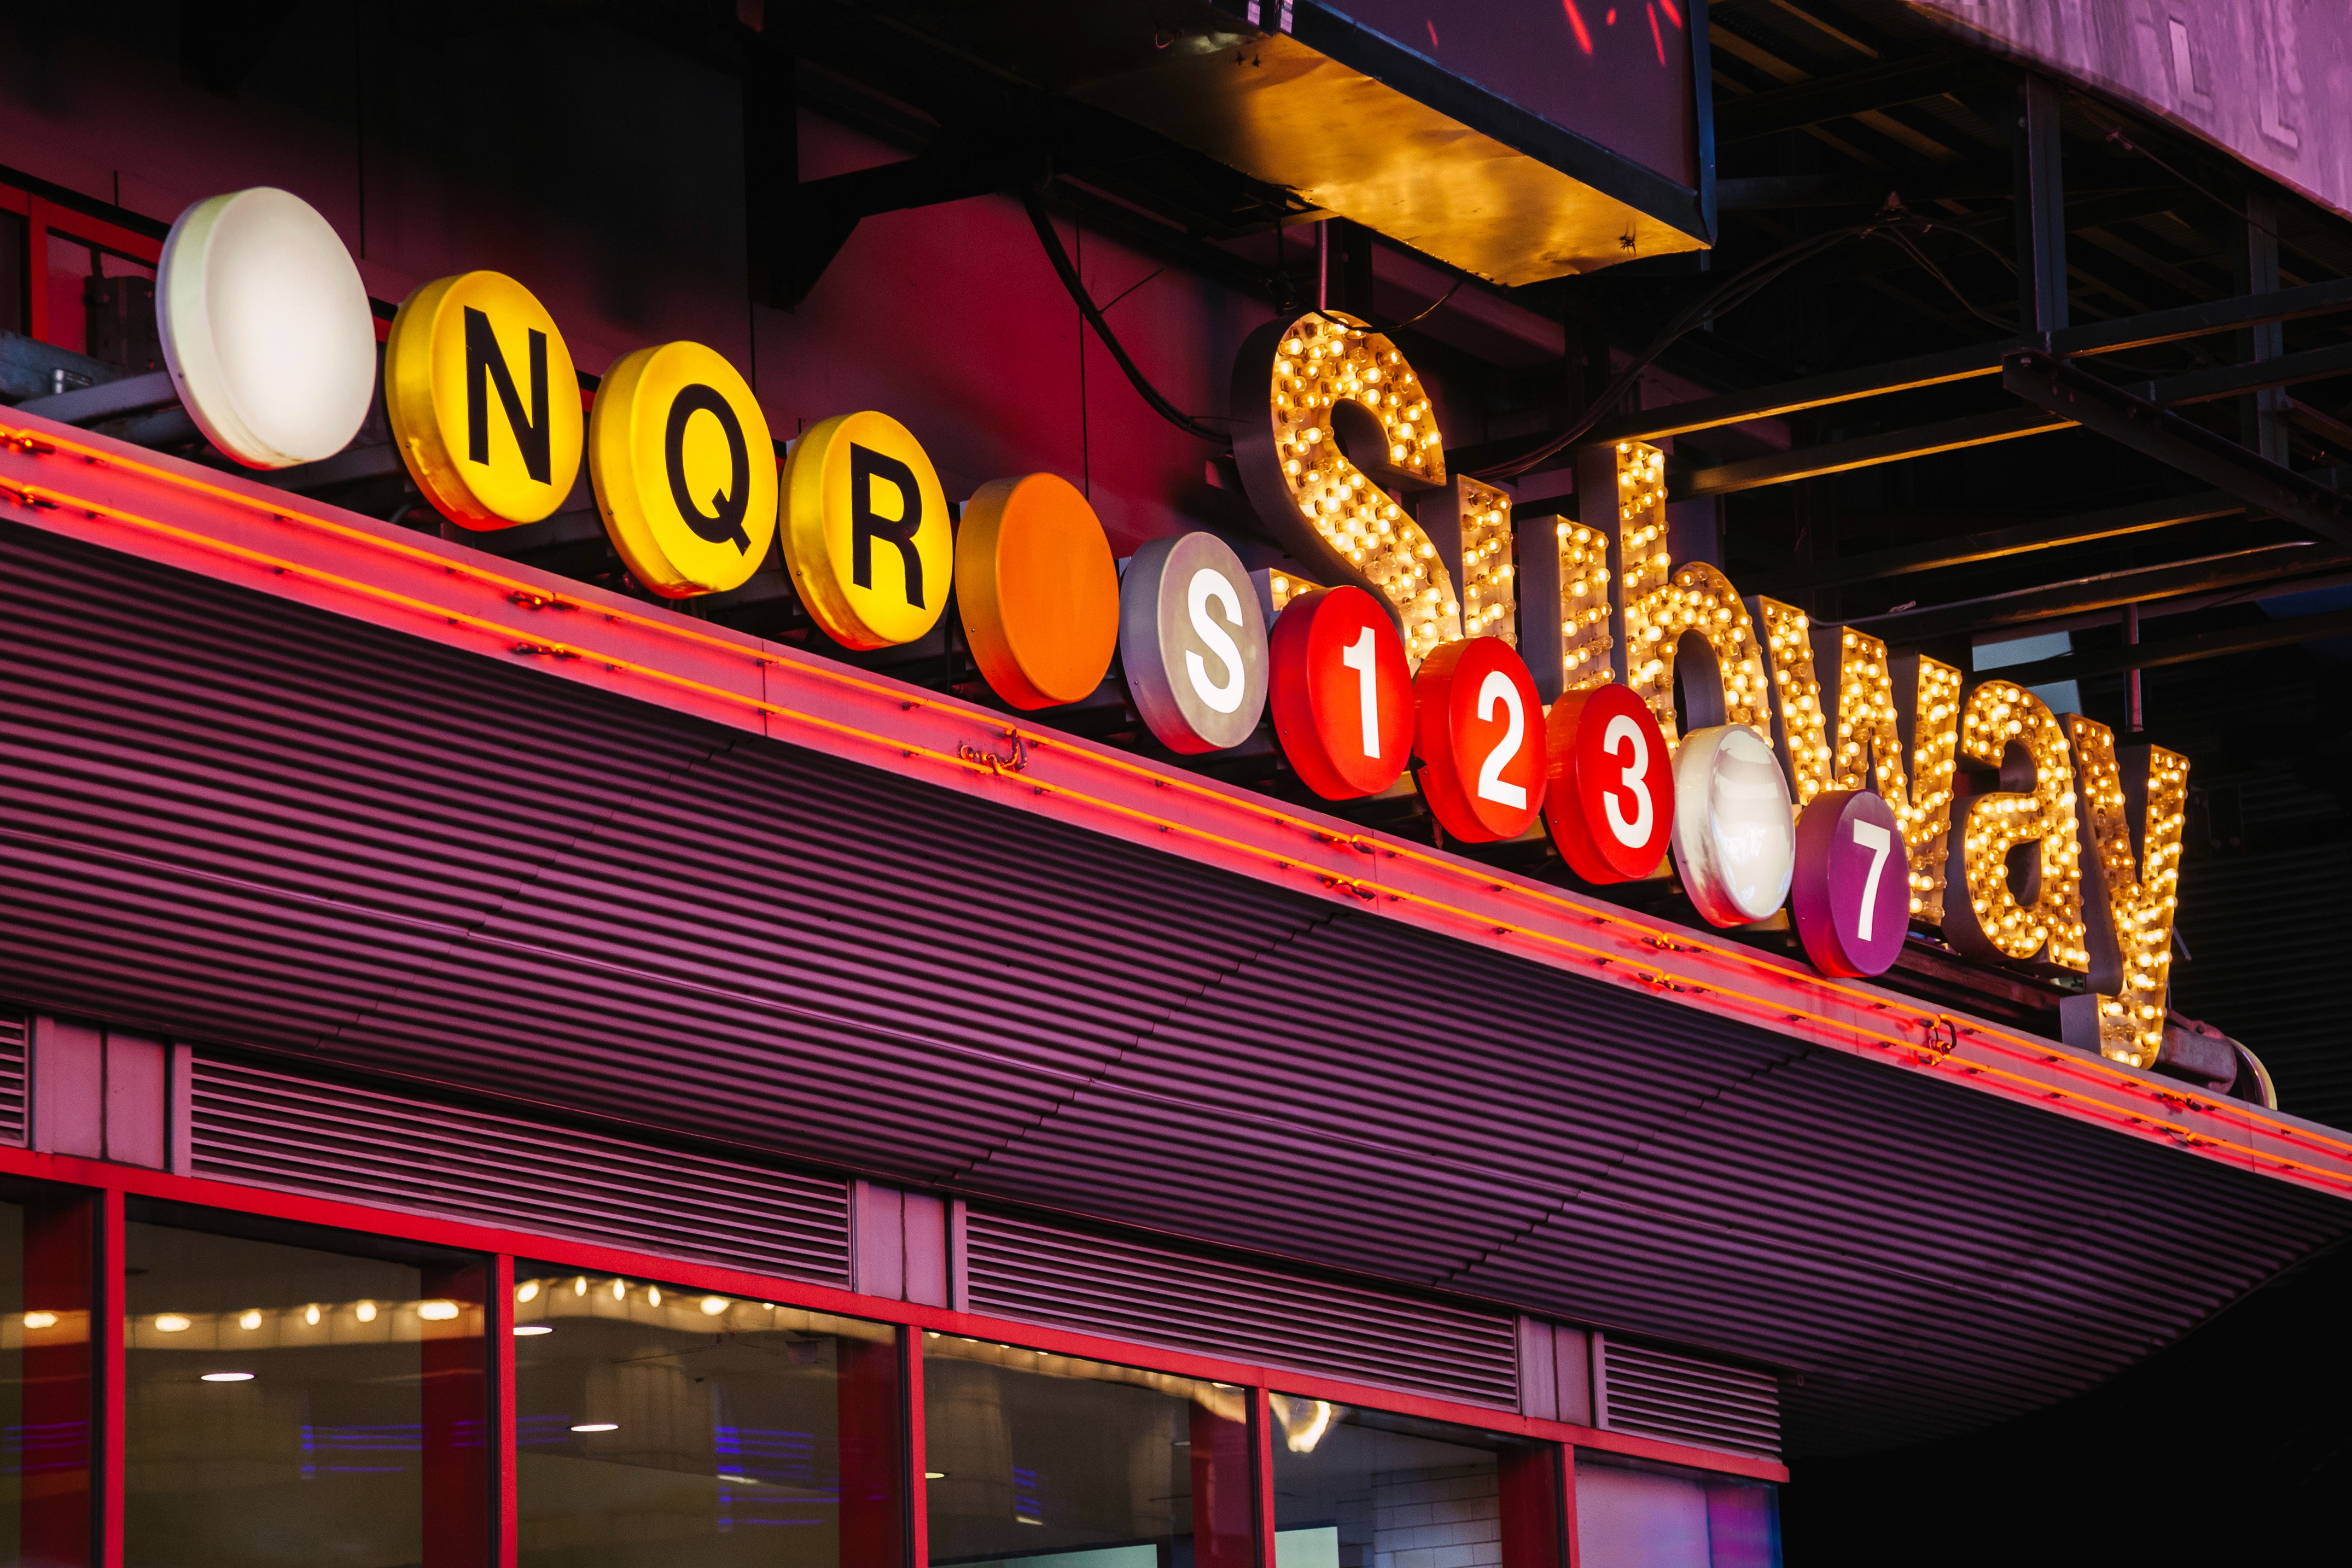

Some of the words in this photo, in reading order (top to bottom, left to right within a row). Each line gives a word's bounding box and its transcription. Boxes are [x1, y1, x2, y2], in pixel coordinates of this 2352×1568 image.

[464, 308, 551, 485] N
[667, 386, 750, 554] Q
[851, 444, 925, 609] R
[1185, 568, 1245, 714] S
[1343, 626, 1380, 759] 1
[1477, 671, 1526, 811] 2
[1603, 715, 1654, 848] 3
[1853, 818, 1891, 942] 7
